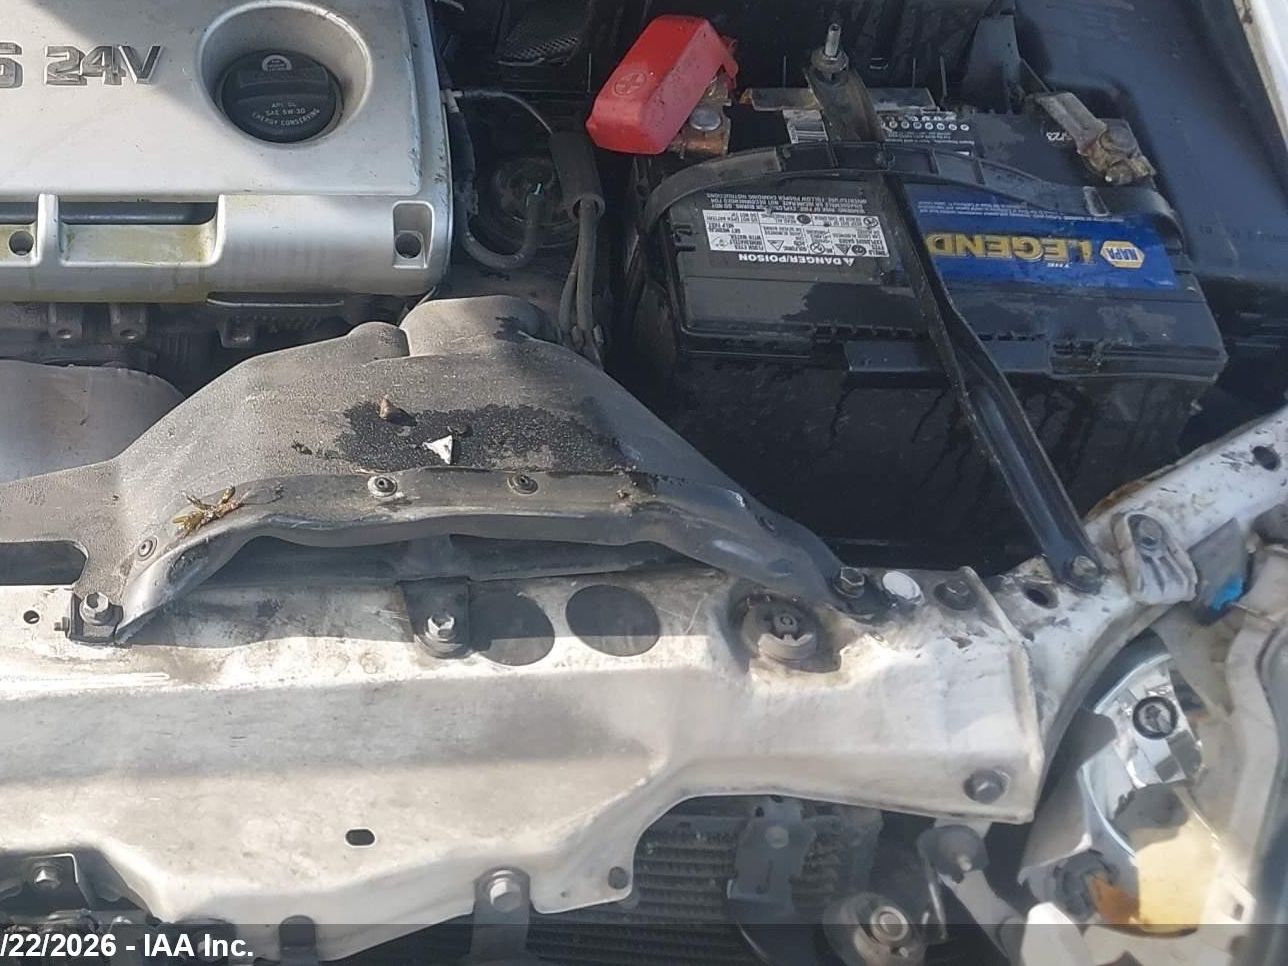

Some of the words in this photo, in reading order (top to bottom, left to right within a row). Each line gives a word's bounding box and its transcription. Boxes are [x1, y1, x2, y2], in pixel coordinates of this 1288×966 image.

[43, 43, 167, 87] 24V
[738, 253, 843, 265] DANGER/POISON
[1106, 247, 1138, 261] NAPA
